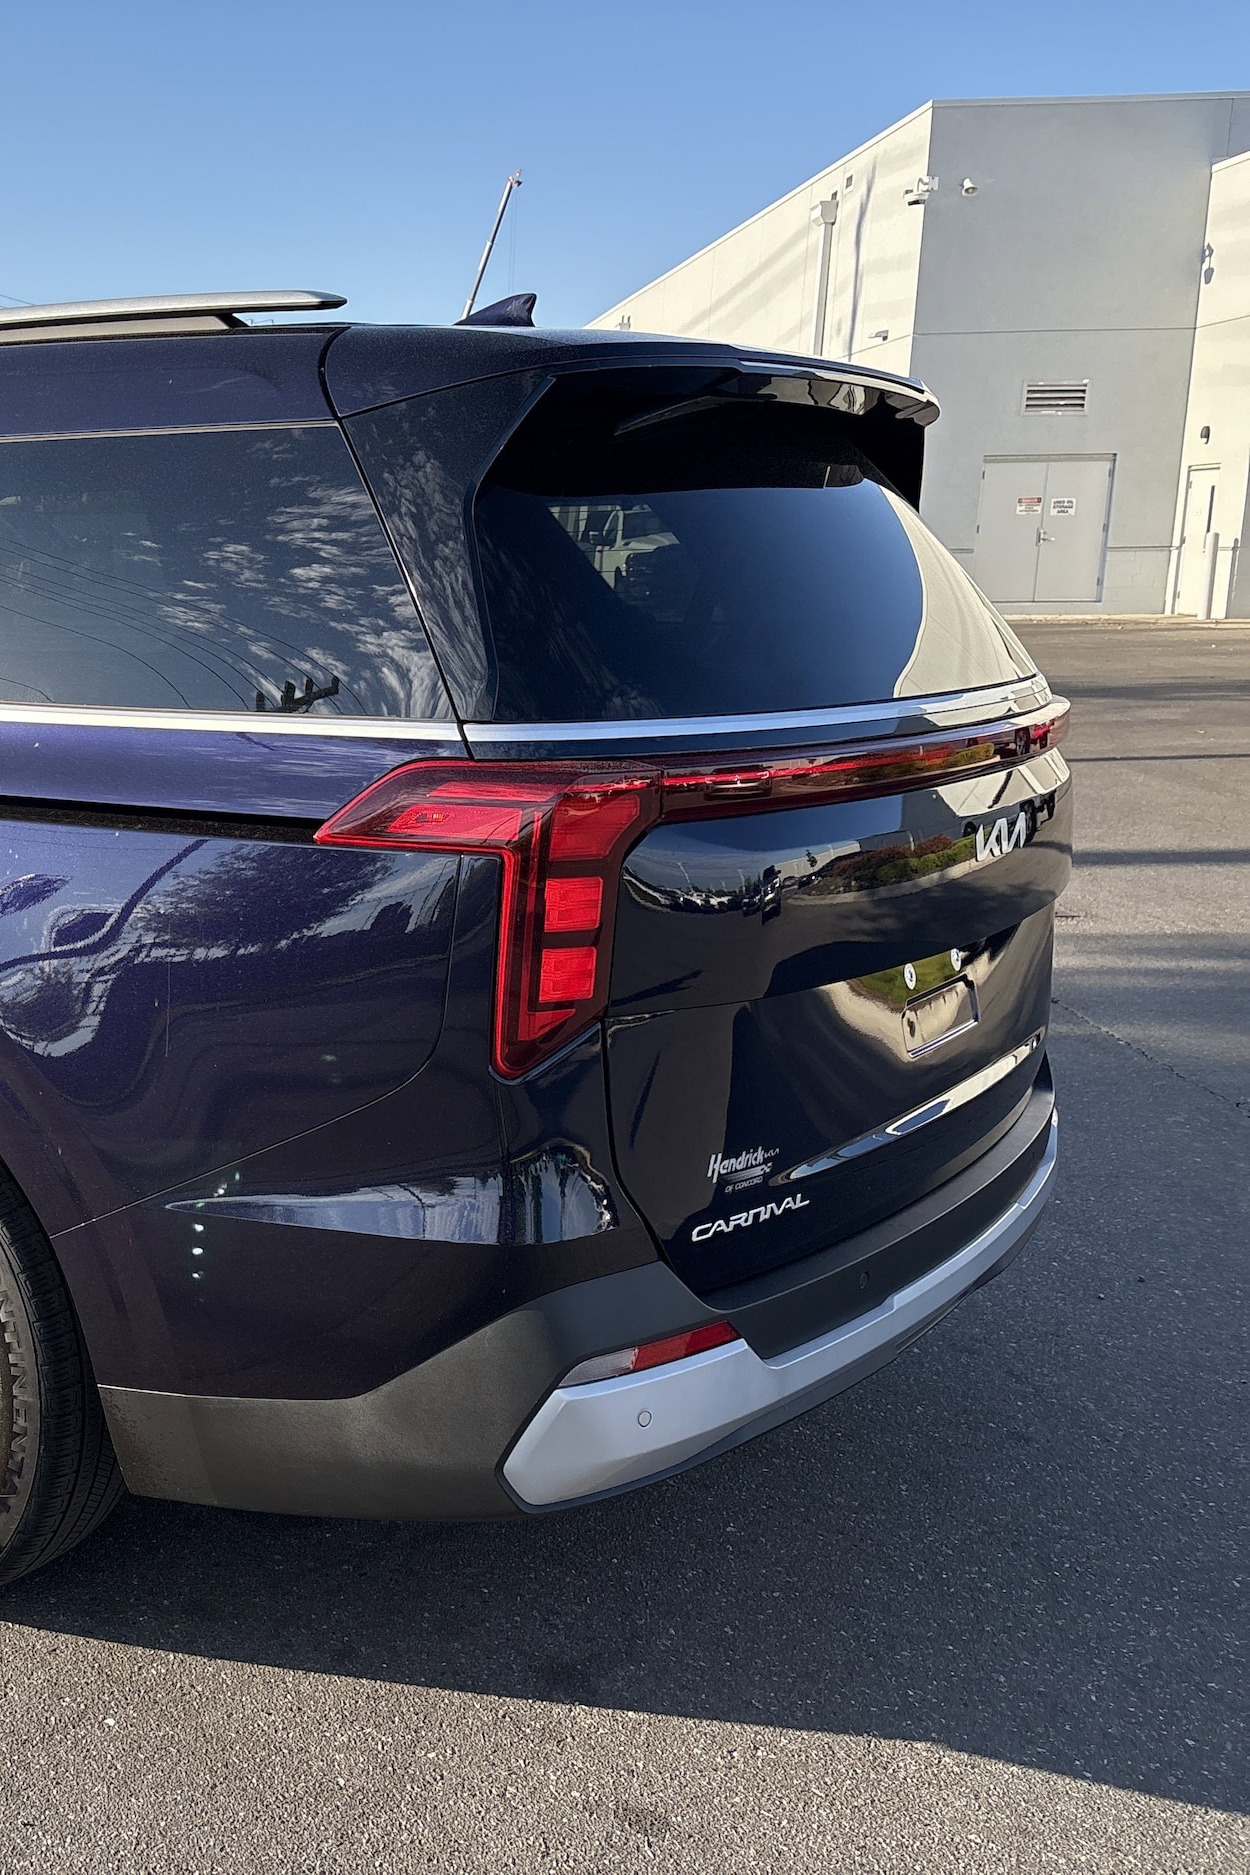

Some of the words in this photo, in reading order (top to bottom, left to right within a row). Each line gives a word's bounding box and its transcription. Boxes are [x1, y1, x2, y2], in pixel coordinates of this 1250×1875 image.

[707, 1145, 764, 1184] Hendrick
[725, 1185, 734, 1194] OF
[691, 1193, 810, 1243] CARNIVAL
